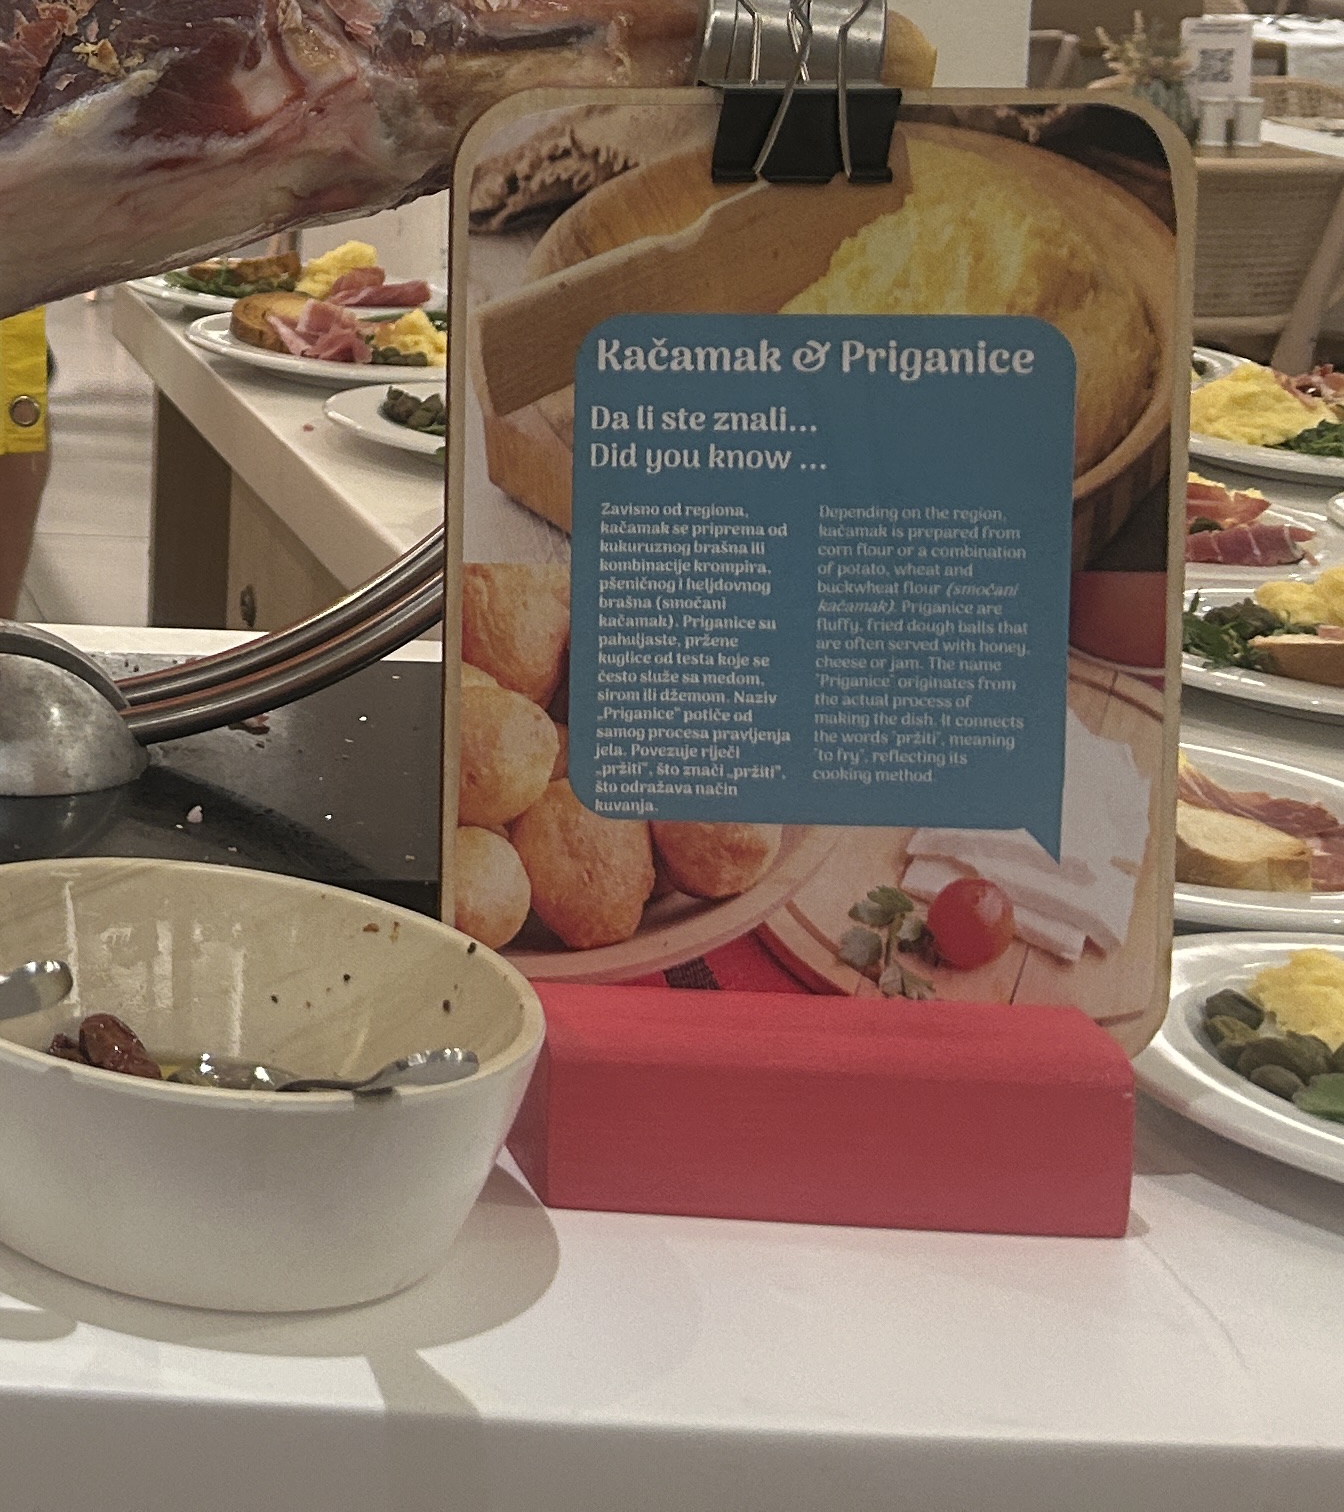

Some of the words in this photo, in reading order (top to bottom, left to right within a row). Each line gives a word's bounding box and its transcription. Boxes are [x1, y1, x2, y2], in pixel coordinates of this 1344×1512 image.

[597, 339, 781, 372] Kačamak
[792, 341, 831, 370] &
[842, 341, 1034, 382] Priganice
[591, 406, 629, 430] Da
[636, 406, 656, 430] li
[662, 408, 706, 432] ste
[591, 443, 637, 470] Did
[645, 447, 700, 474] you
[708, 444, 791, 469] know
[600, 503, 659, 515] Zavisno
[663, 503, 682, 516] od
[819, 505, 898, 521] Depending
[902, 508, 921, 519] on
[925, 506, 949, 519] the
[600, 522, 669, 534] kačamak
[673, 524, 687, 535] se
[692, 523, 765, 538] priprema
[768, 523, 787, 536] od
[819, 524, 887, 538] kačamak
[893, 525, 904, 538] is
[908, 525, 978, 541] prepared
[982, 526, 1021, 540] from
[600, 540, 691, 555] kukuruznog
[694, 541, 748, 554] brašna
[751, 542, 765, 554] ili
[818, 546, 852, 556] corn
[857, 543, 894, 556] flour
[898, 546, 914, 556] or
[918, 546, 927, 556] a
[931, 545, 1026, 559] combination
[600, 558, 691, 574] kombinacije
[694, 559, 771, 575] krompira,
[818, 562, 832, 575] of
[837, 563, 890, 577] potato,
[894, 563, 940, 576] wheat
[945, 563, 973, 577] and
[599, 577, 675, 593] pšeničnog
[818, 580, 899, 593] buckwheat
[904, 581, 941, 594] flour
[599, 597, 651, 608] brašna
[902, 601, 973, 616] Priganice
[977, 604, 1003, 615] are
[683, 615, 756, 630] Priganice
[759, 619, 777, 630] su
[817, 618, 863, 634] fluffy,
[868, 619, 903, 632] fried
[907, 620, 954, 636] dough
[958, 620, 993, 634] balls
[998, 621, 1027, 634] that
[685, 635, 739, 648] pržene
[816, 640, 841, 649] are
[845, 637, 884, 650] often
[888, 638, 938, 651] served
[943, 639, 975, 652] with
[598, 652, 651, 667] kuglice
[655, 652, 673, 664] od
[677, 653, 714, 665] testa
[718, 653, 749, 669] koje
[753, 657, 770, 666] se
[816, 656, 867, 668] cheese
[870, 659, 885, 669] or
[890, 656, 924, 672] jam.
[929, 657, 954, 670] The
[960, 660, 1002, 671] name
[598, 671, 636, 682] često
[640, 671, 678, 682] služe
[682, 673, 699, 683] sa
[703, 672, 764, 685] medom,
[898, 676, 974, 691] originates
[978, 676, 1016, 691] from
[597, 689, 639, 701] sirom
[643, 690, 657, 701] ili
[734, 690, 777, 704] Naziv
[815, 693, 838, 705] the
[842, 694, 888, 706] actual
[893, 696, 952, 709] process
[956, 695, 972, 708] of
[683, 709, 730, 723] potiče
[734, 709, 753, 722] od
[815, 712, 869, 727] making
[874, 713, 897, 726] the
[942, 713, 951, 726] It
[956, 715, 1024, 729] connects
[596, 727, 645, 741] samog
[648, 728, 709, 741] procesa
[713, 728, 790, 743] pravljenja
[814, 730, 837, 742] the
[842, 731, 888, 743] words
[950, 733, 1015, 750] meaning
[631, 744, 698, 759] Povezuje
[701, 745, 740, 760] riječi
[873, 750, 945, 767] reflecting
[950, 751, 967, 765] its
[657, 763, 679, 776] što
[683, 764, 724, 776] znači
[813, 767, 871, 784] cooking
[595, 781, 616, 792] što
[621, 781, 691, 794] odražava
[695, 783, 738, 795] način
[595, 799, 658, 814] kuvanja.
